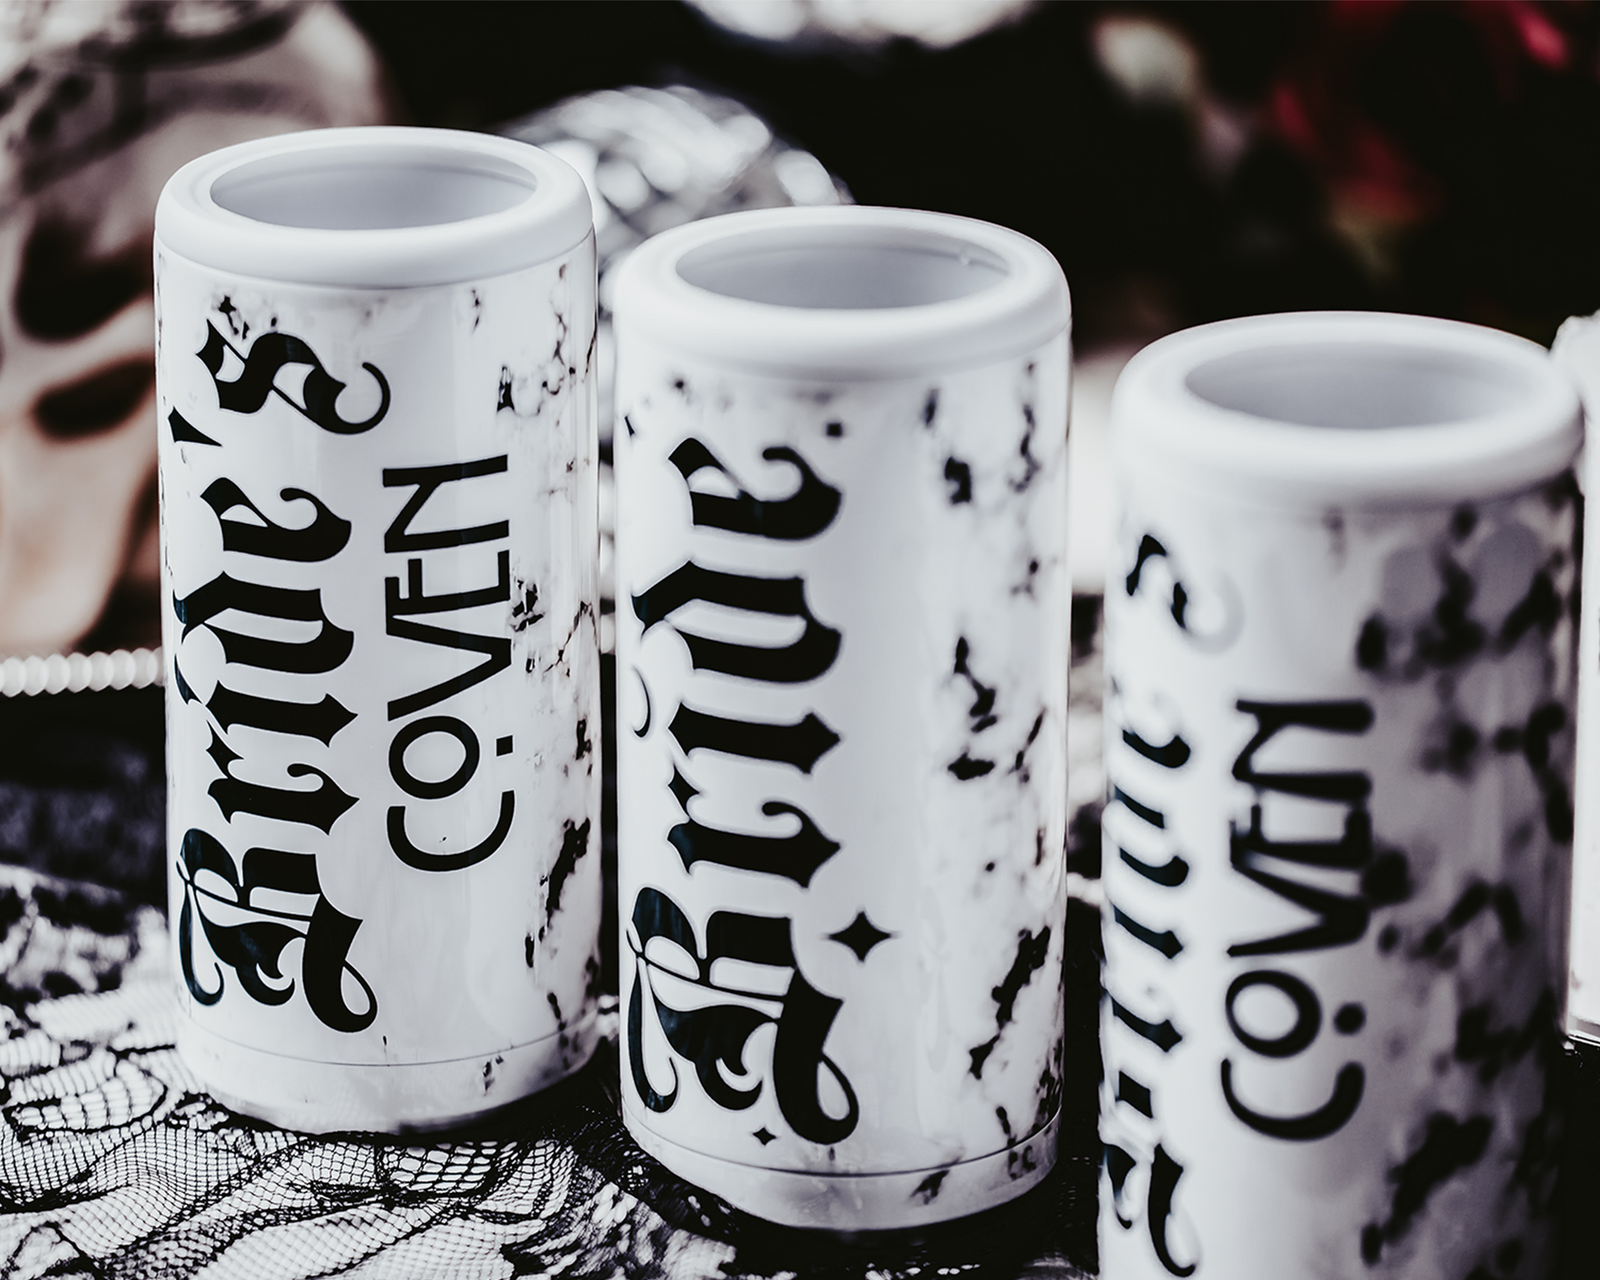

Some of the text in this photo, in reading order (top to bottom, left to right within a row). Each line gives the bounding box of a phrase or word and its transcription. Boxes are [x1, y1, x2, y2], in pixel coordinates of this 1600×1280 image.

[168, 319, 391, 1033] Bride's
[382, 454, 516, 873] COVEN
[626, 437, 859, 1144] Bride
[1221, 699, 1374, 1142] COVEN
